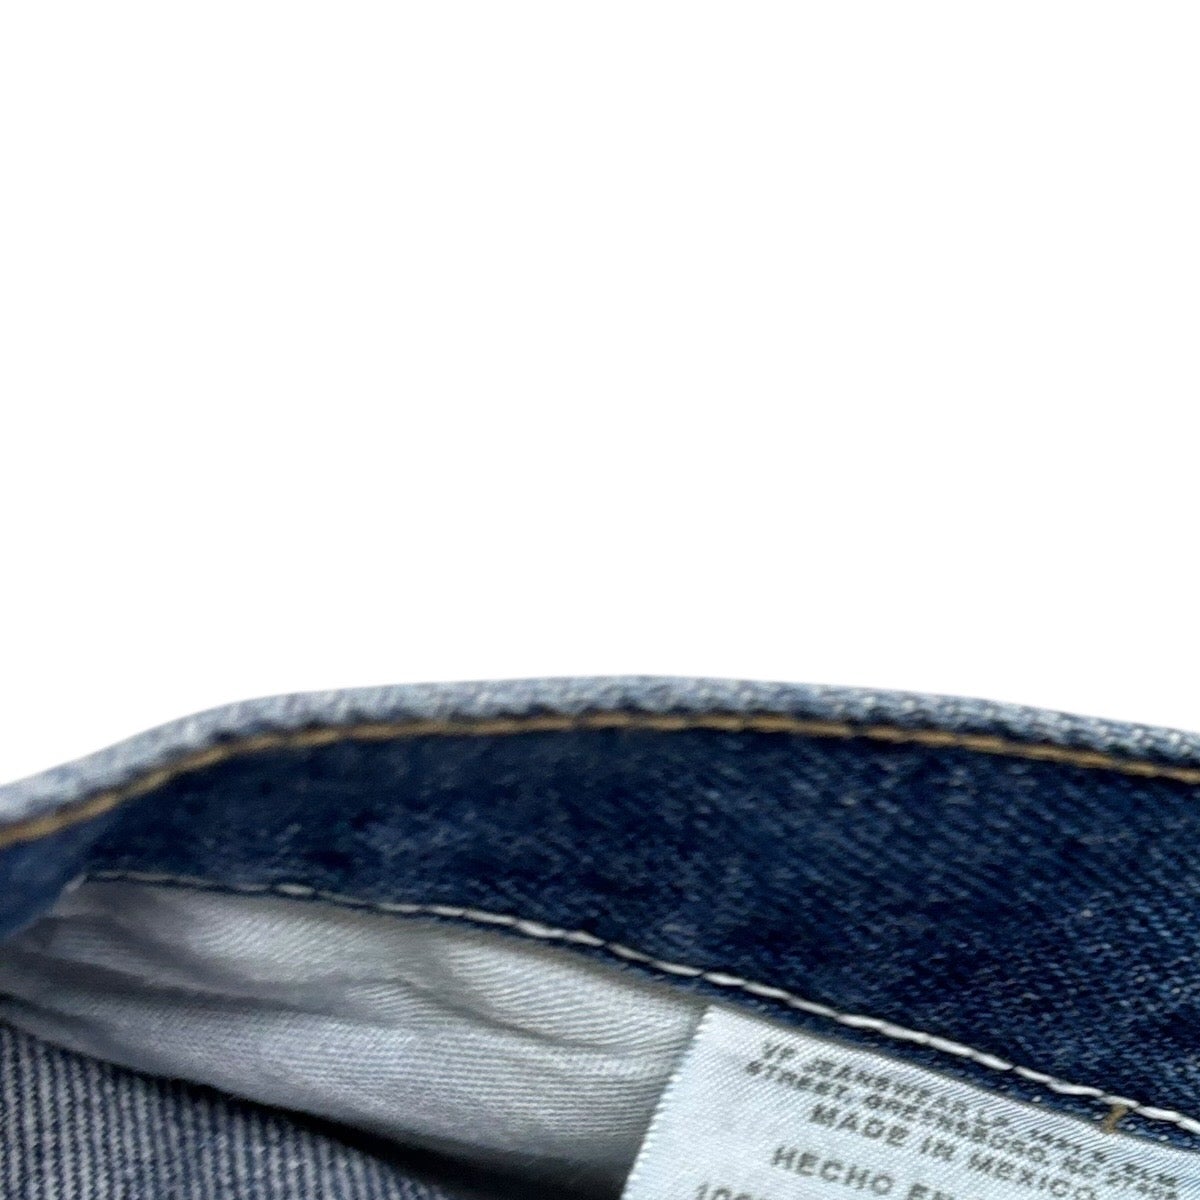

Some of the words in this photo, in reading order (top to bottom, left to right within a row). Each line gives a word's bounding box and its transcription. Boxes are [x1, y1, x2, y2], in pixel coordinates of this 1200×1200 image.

[809, 1104, 910, 1148] MADE
[919, 1137, 956, 1162] IN
[771, 1146, 894, 1195] HECHO
